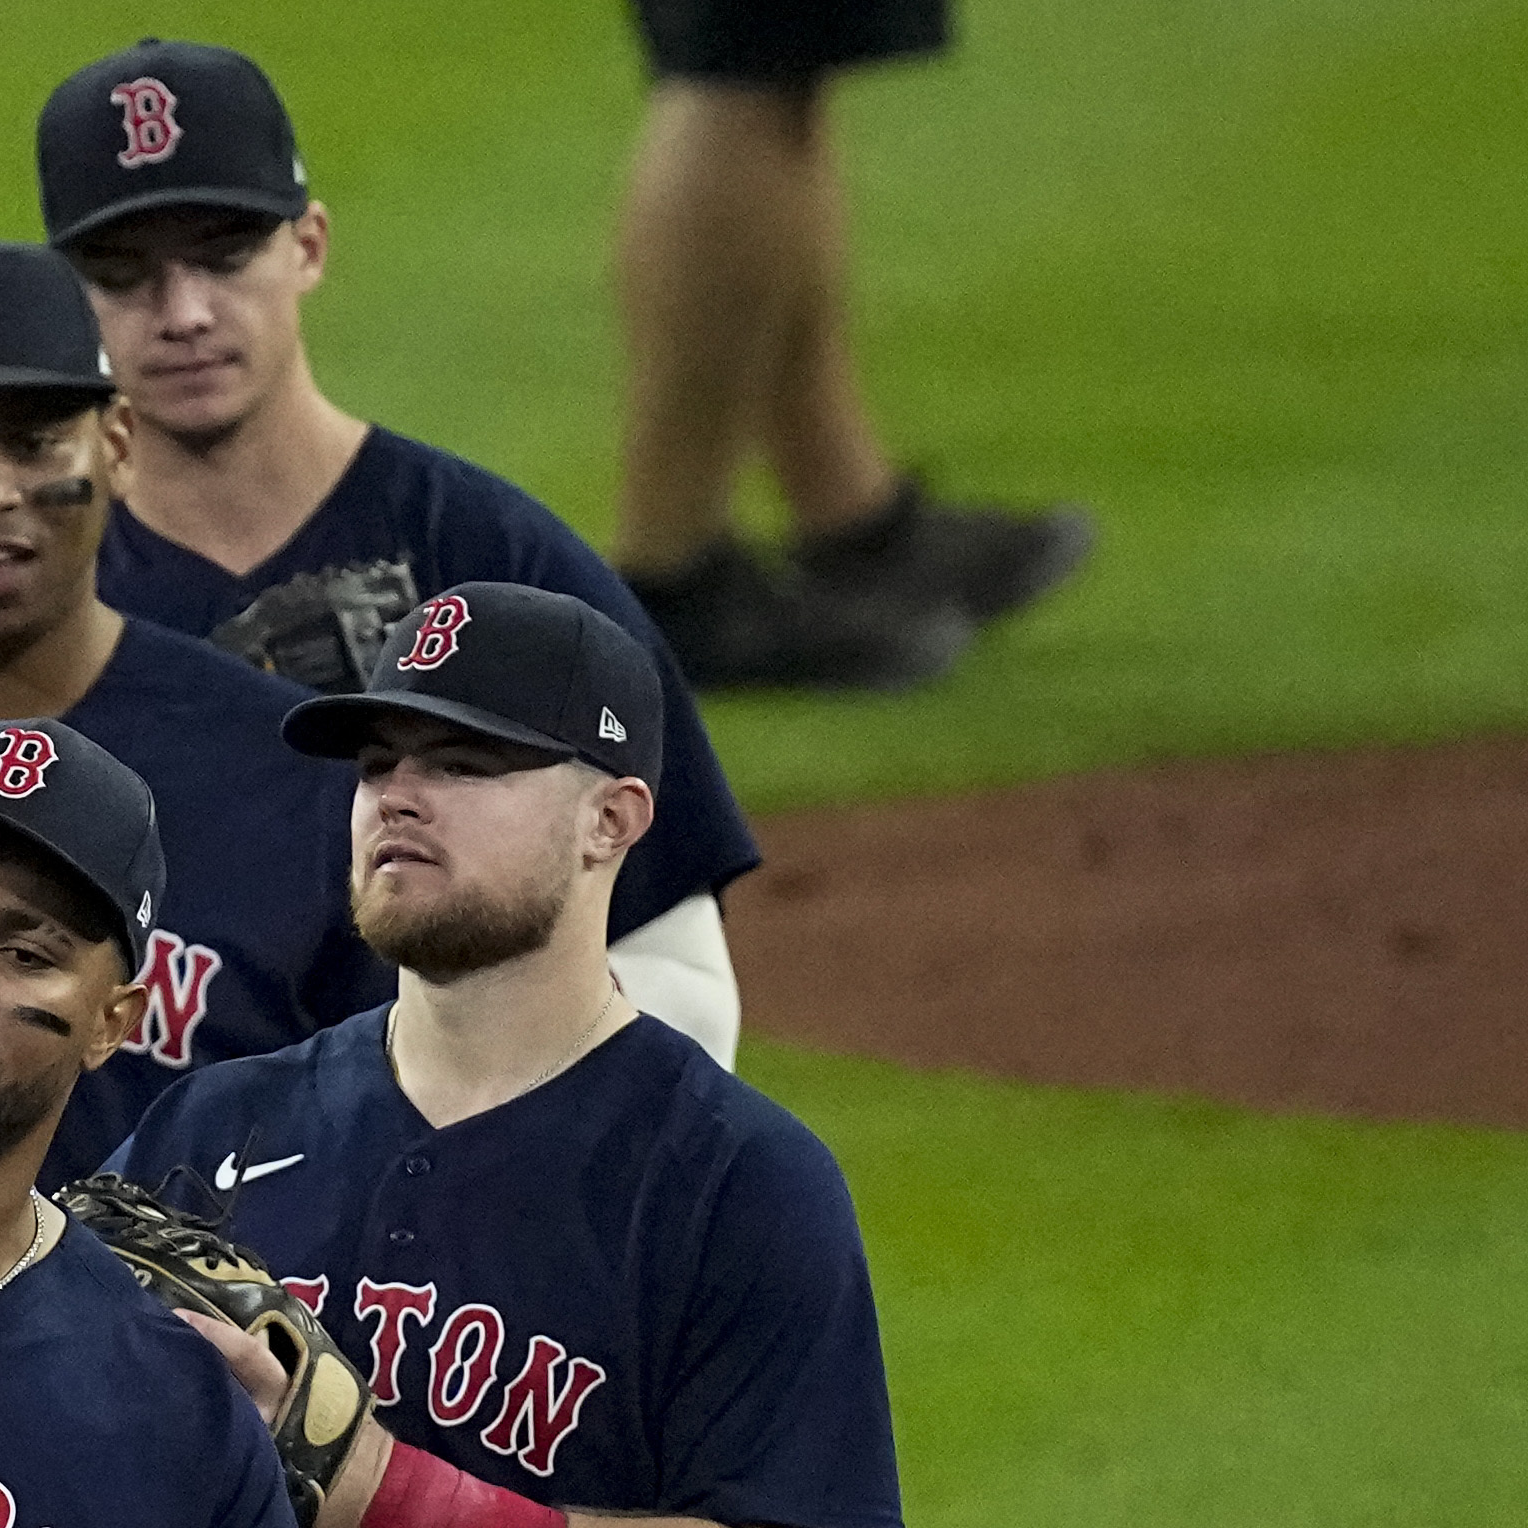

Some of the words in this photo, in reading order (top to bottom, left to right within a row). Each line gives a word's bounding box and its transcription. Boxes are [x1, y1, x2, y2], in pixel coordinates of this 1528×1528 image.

[109, 77, 184, 169] B
[397, 594, 471, 670] B
[281, 1274, 606, 1477] TON
